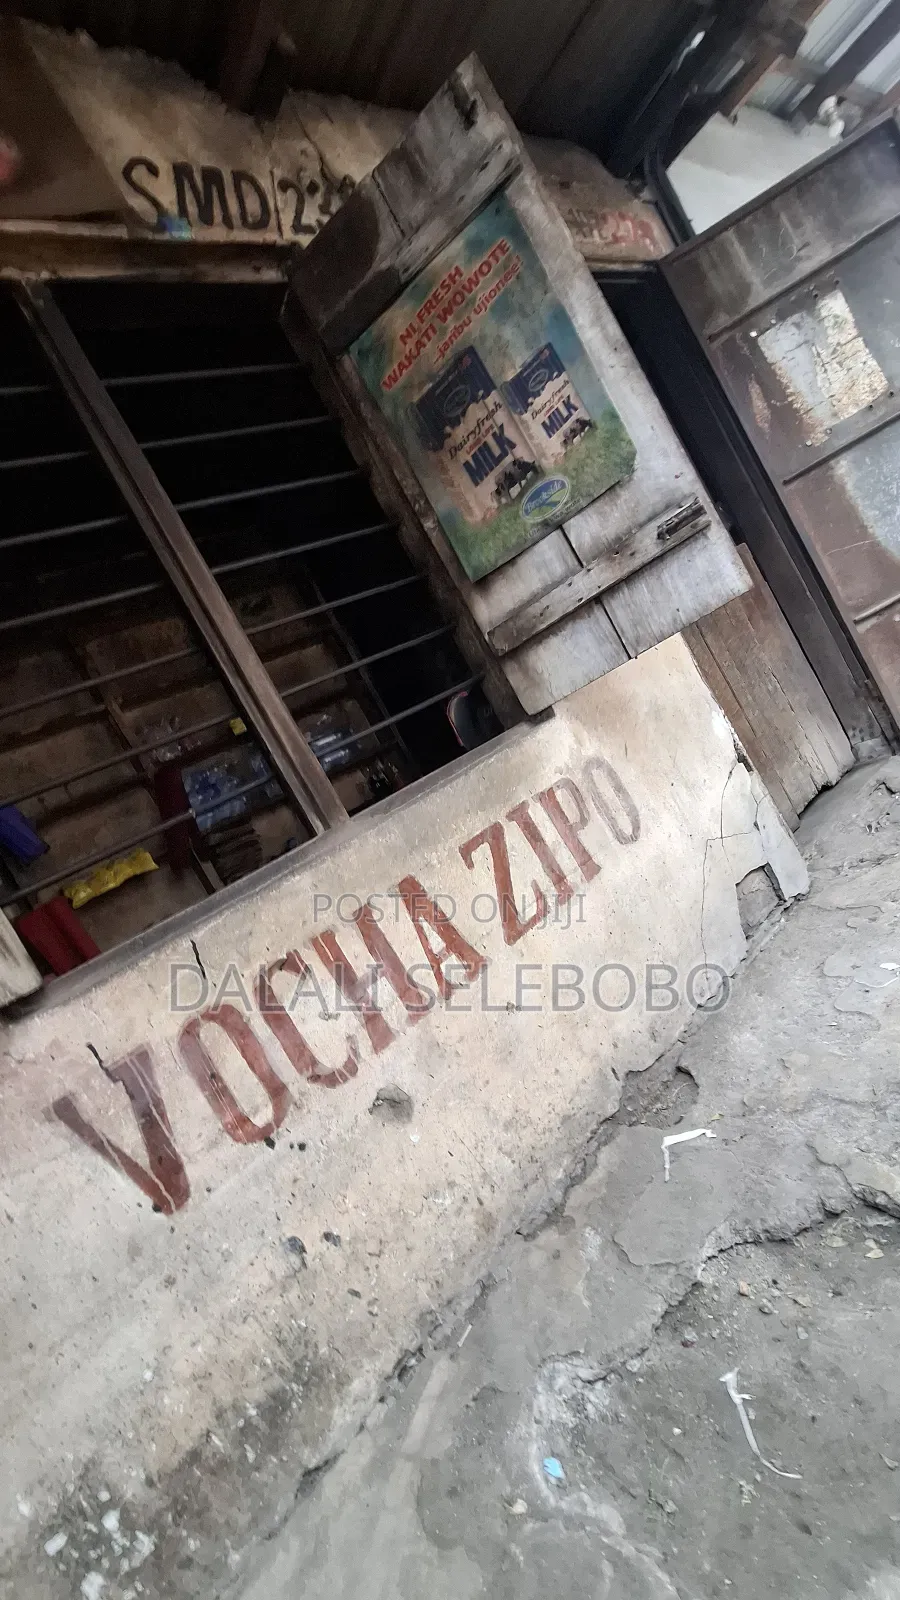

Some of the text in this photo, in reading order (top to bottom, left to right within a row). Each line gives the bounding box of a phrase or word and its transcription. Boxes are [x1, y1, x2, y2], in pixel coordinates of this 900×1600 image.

[381, 323, 437, 391] WAKATI
[436, 239, 512, 324] WOWOTE
[416, 265, 465, 324] FRESH
[449, 401, 503, 460] Dairyfresh
[540, 394, 579, 440] MILK
[463, 423, 517, 487] MILK
[44, 757, 641, 1215] VOCHA ZIPO
